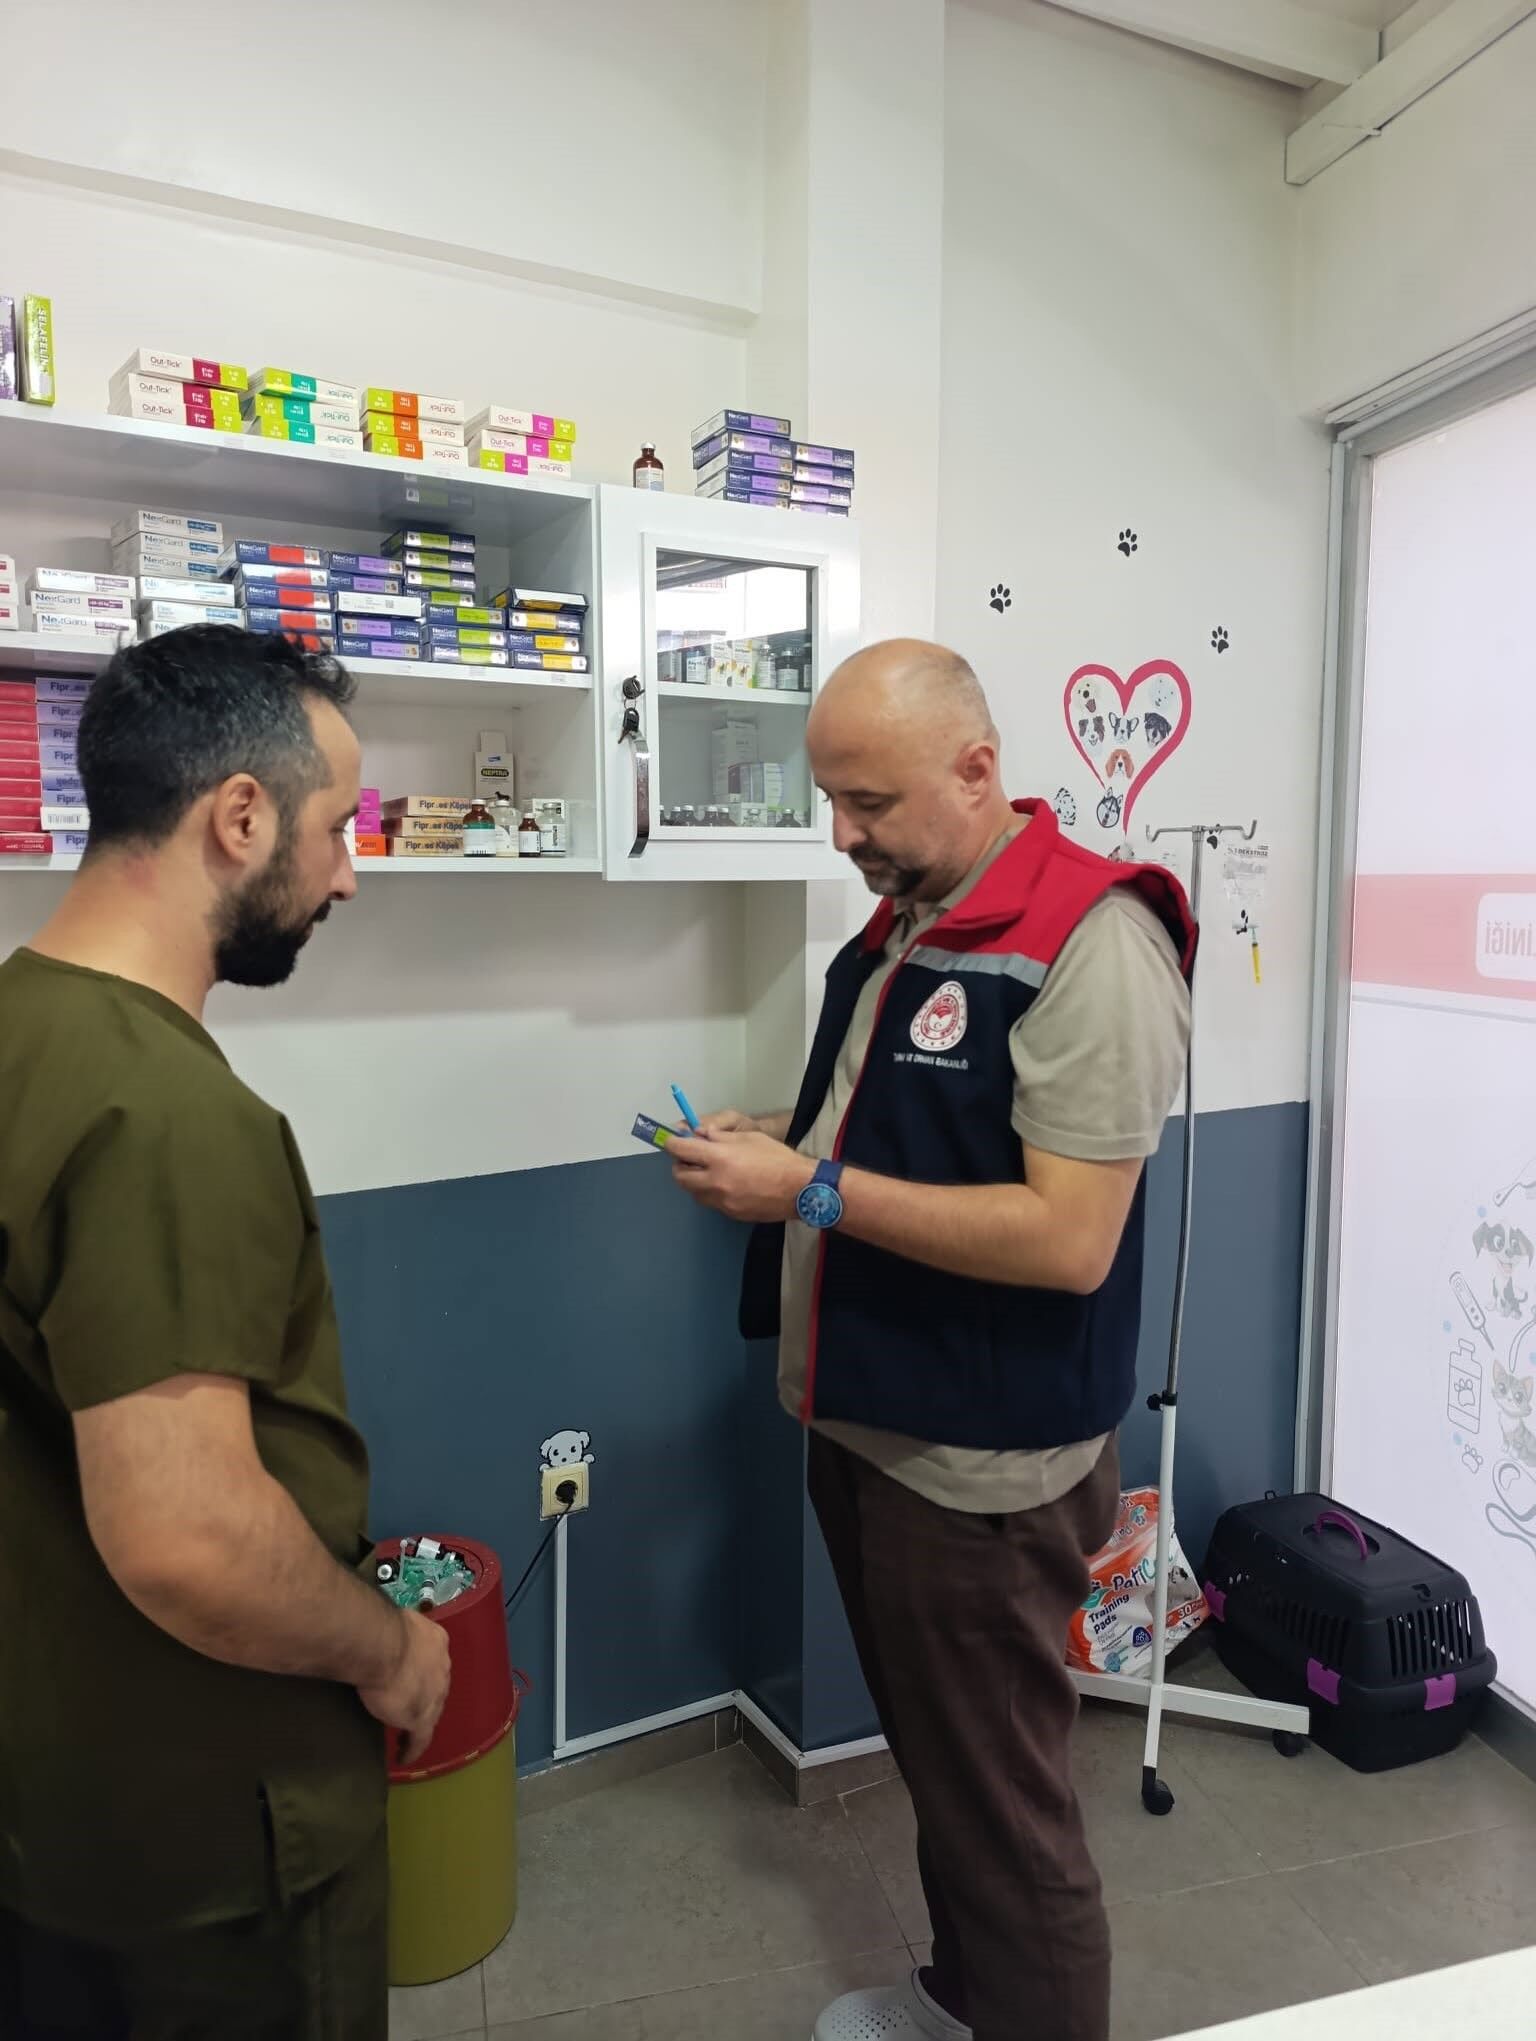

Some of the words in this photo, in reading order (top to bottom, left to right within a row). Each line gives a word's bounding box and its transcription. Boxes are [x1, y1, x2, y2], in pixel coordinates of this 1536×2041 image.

[150, 356, 181, 369] Out-Tick
[139, 382, 170, 394] Out-Tick
[142, 403, 173, 415] Out-Tick
[143, 513, 181, 525] NexGard
[145, 535, 184, 547] NexGard
[143, 556, 182, 567] NexGard
[35, 593, 81, 605] NexGard
[1088, 1593, 1130, 1623] Training
[1177, 1603, 1192, 1619] 30
[1093, 1614, 1118, 1635] Pads
